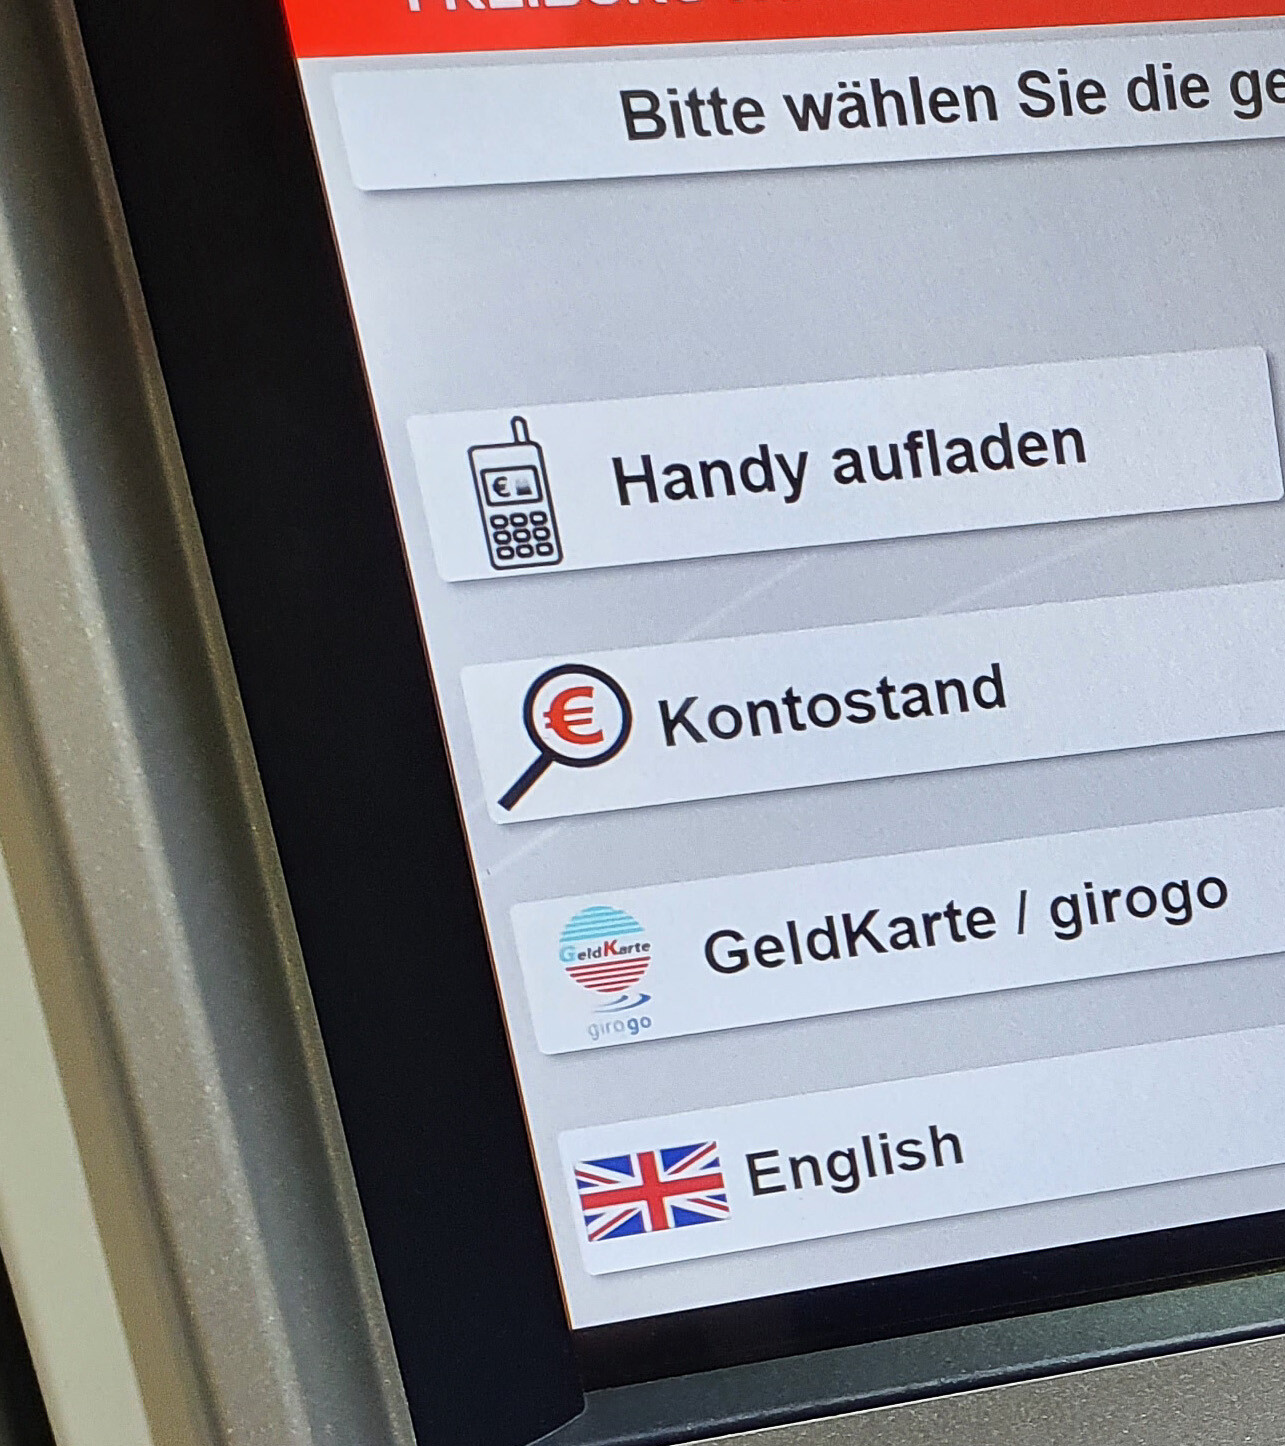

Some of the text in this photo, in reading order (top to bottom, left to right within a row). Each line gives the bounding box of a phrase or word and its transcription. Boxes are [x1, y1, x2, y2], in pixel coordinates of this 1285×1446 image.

[618, 86, 766, 142] Bitte
[783, 75, 999, 133] wählen
[1017, 63, 1108, 120] Sie
[1124, 60, 1211, 114] die
[611, 419, 1088, 507] Handy aufladen
[657, 664, 1008, 747] Kontostand
[559, 939, 651, 962] GeldKarte
[703, 873, 1229, 977] GeldKarte / girogo
[588, 1016, 652, 1041] girogo
[743, 1123, 965, 1198] English
